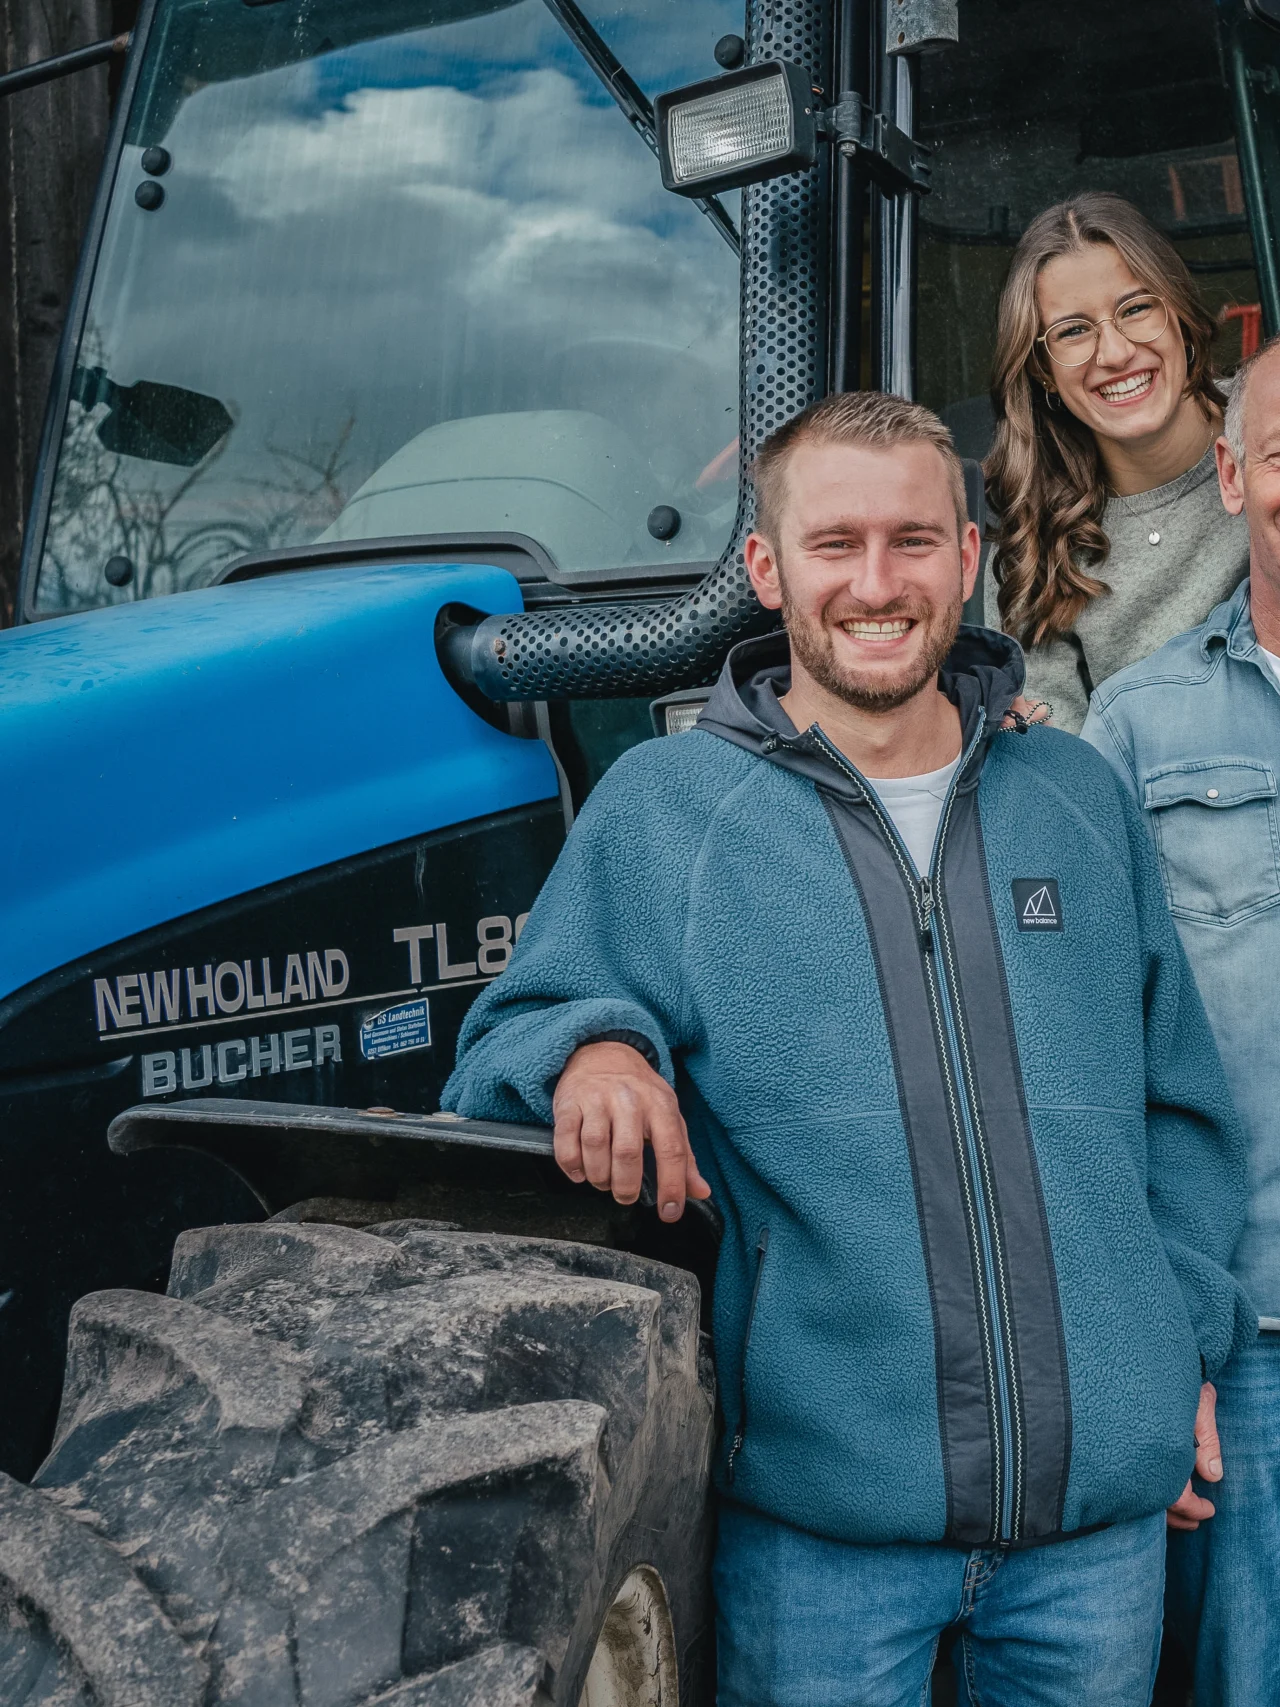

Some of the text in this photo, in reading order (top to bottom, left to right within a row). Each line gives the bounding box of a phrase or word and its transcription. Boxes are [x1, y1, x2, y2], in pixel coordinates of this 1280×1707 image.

[94, 948, 350, 1032] NEW HOLLAND
[388, 1006, 425, 1022] Landtechnik
[141, 1024, 342, 1097] BUCHER
